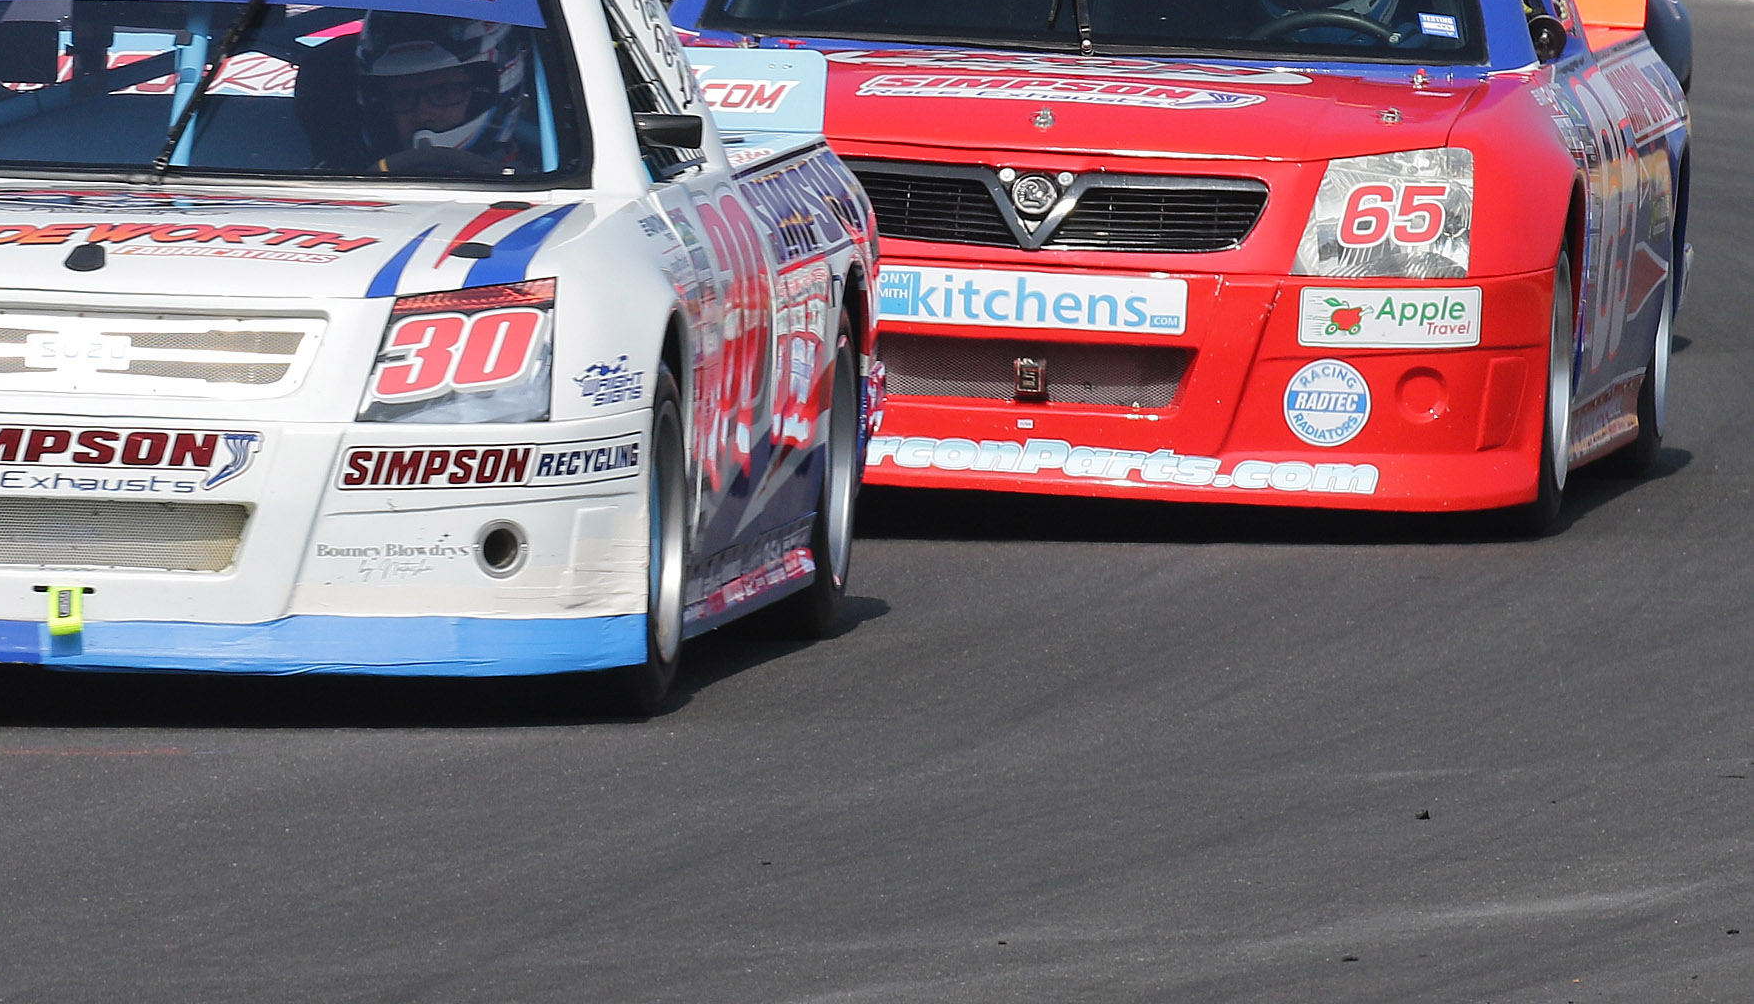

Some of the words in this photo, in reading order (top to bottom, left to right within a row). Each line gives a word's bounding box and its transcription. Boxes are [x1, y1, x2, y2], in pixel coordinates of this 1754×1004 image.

[864, 88, 960, 96] Race
[975, 90, 1163, 105] Exhausts
[882, 76, 1197, 99] SIMPSON
[1338, 183, 1450, 246] 65
[109, 244, 338, 264] FABRICATIONS
[911, 274, 1148, 327] kitchens
[1374, 296, 1466, 327] Apple
[1426, 321, 1472, 337] Travel
[373, 309, 545, 401] 30
[1299, 365, 1358, 390] RACING
[1295, 392, 1359, 411] RADTEC
[1292, 412, 1359, 441] RADIATORS
[343, 446, 534, 486] SIMPSON
[535, 442, 640, 479] RECYCLING
[0, 470, 197, 495] Exhausts
[316, 544, 381, 561] Bouncy
